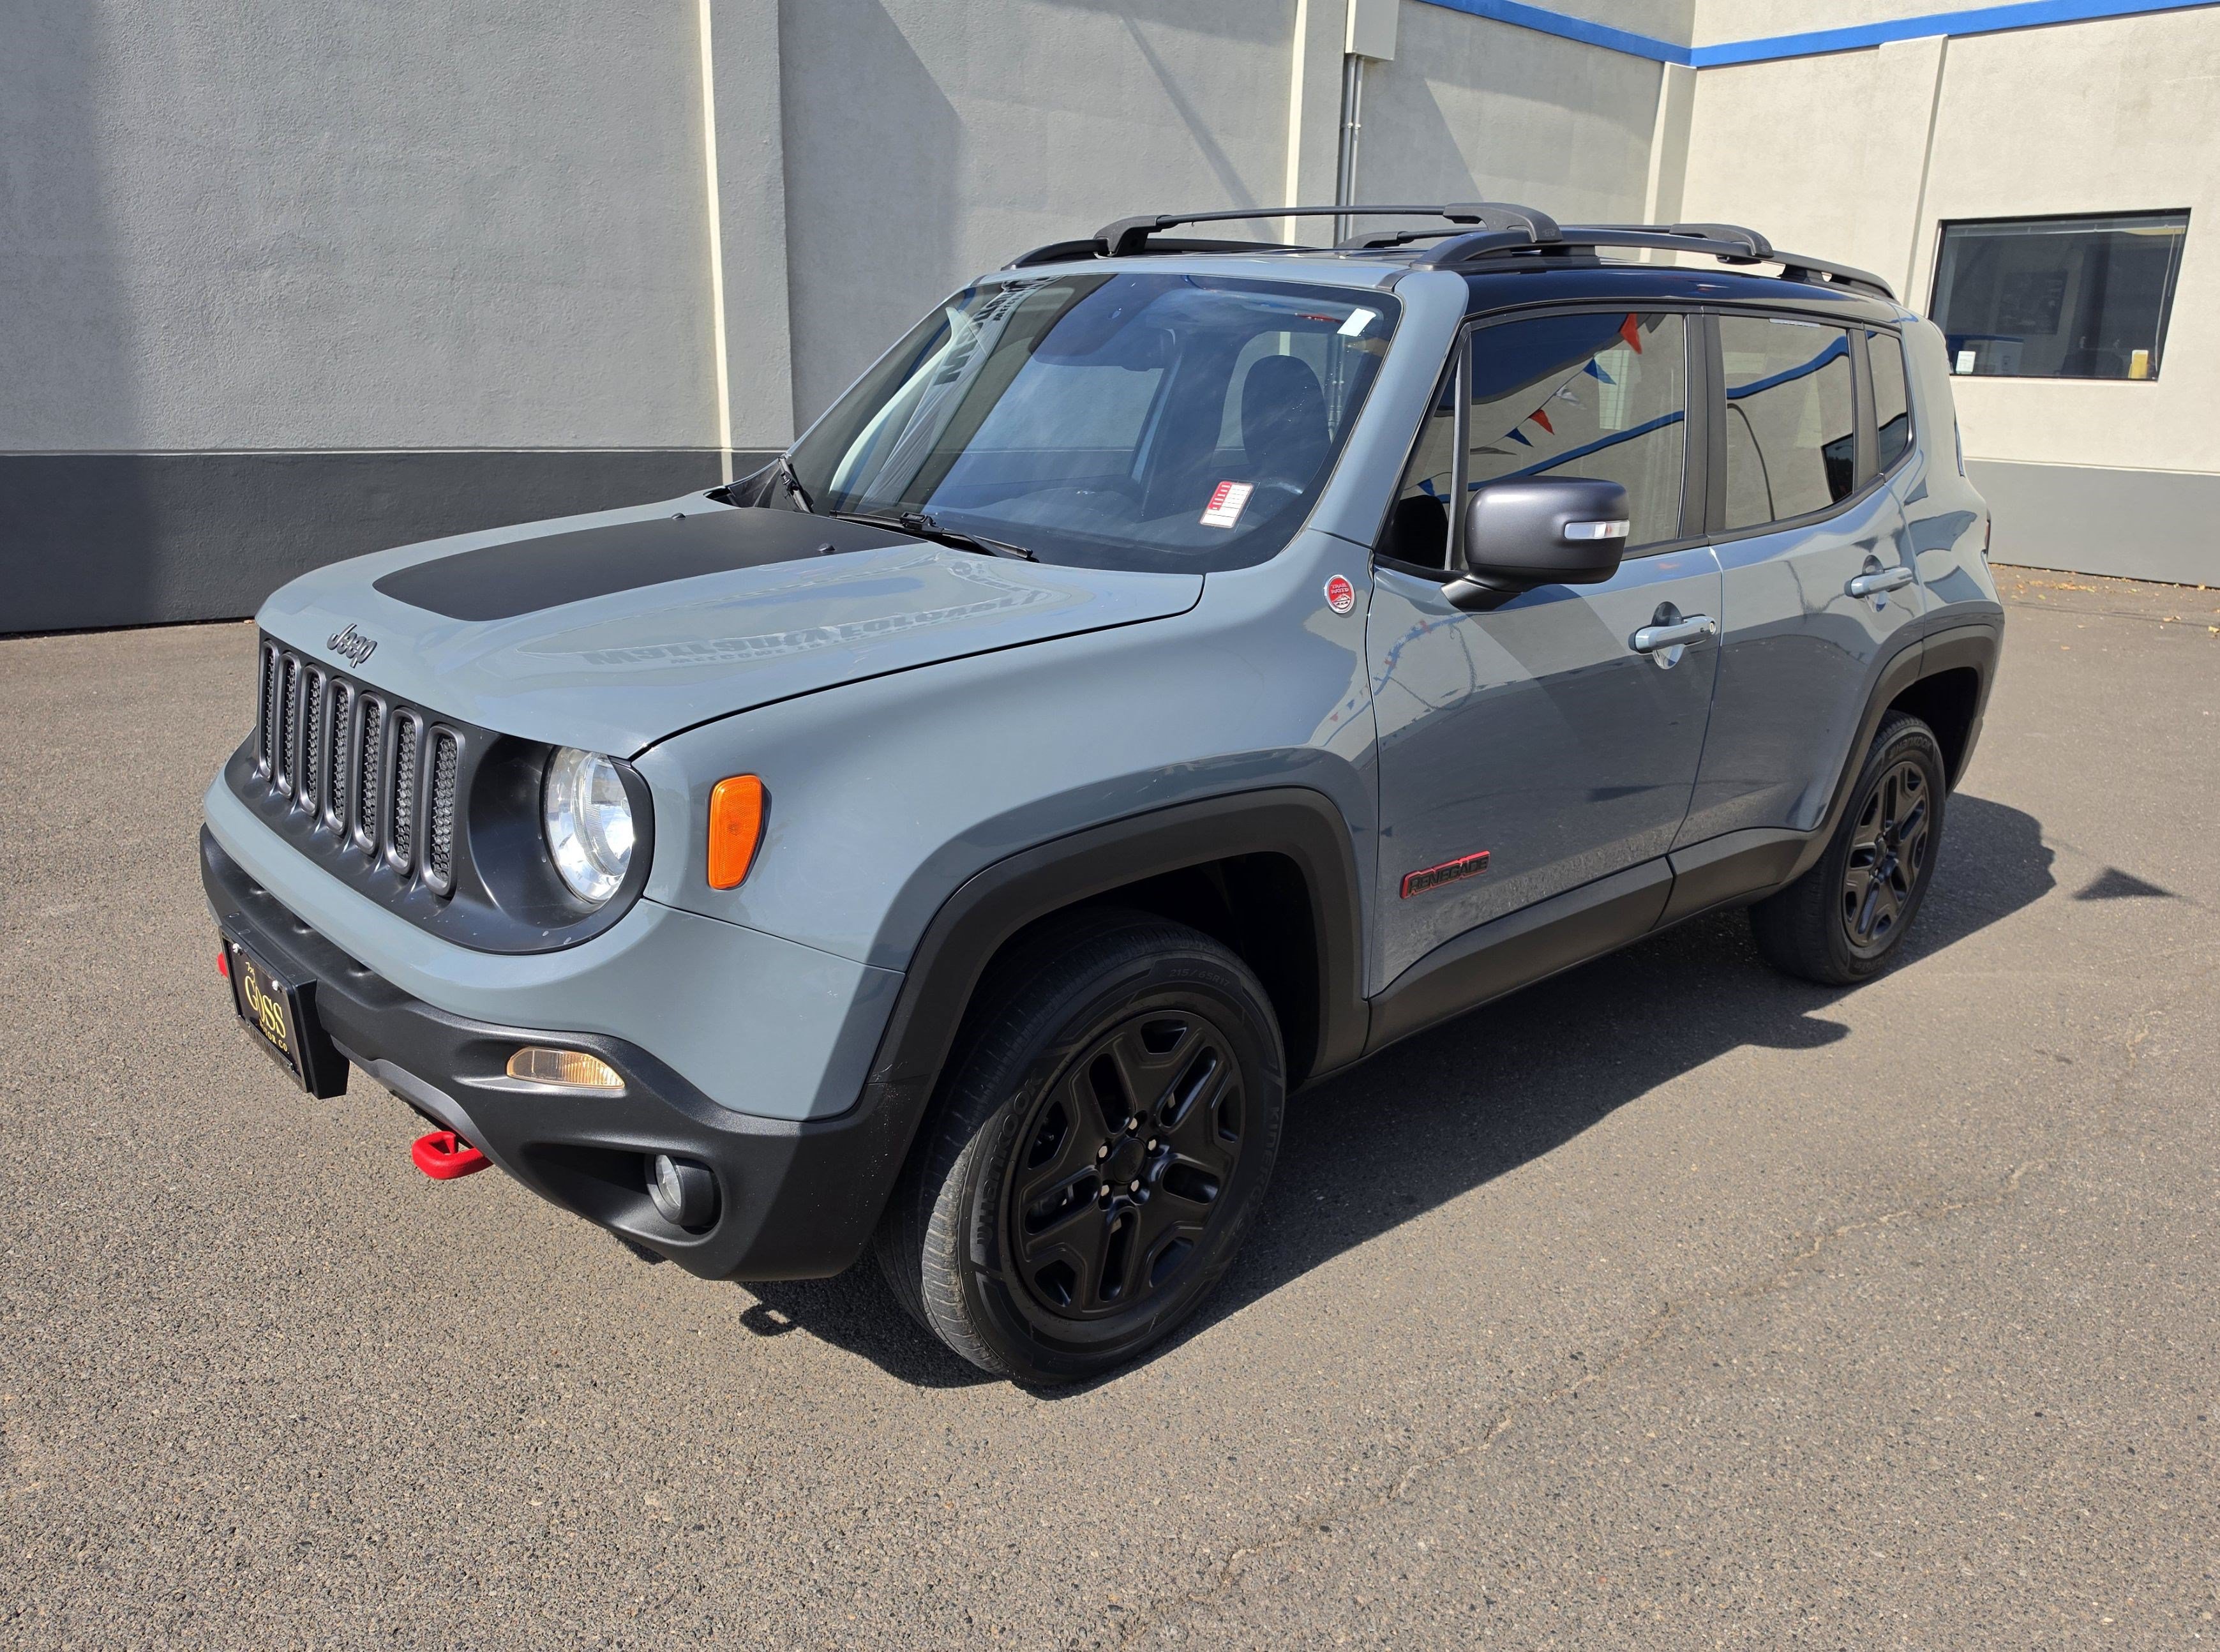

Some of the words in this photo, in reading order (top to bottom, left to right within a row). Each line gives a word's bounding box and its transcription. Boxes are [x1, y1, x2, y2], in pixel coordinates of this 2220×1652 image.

[327, 623, 378, 669] Jeep
[1403, 852, 1490, 897] RENEGADE
[244, 975, 287, 1039] GOSS
